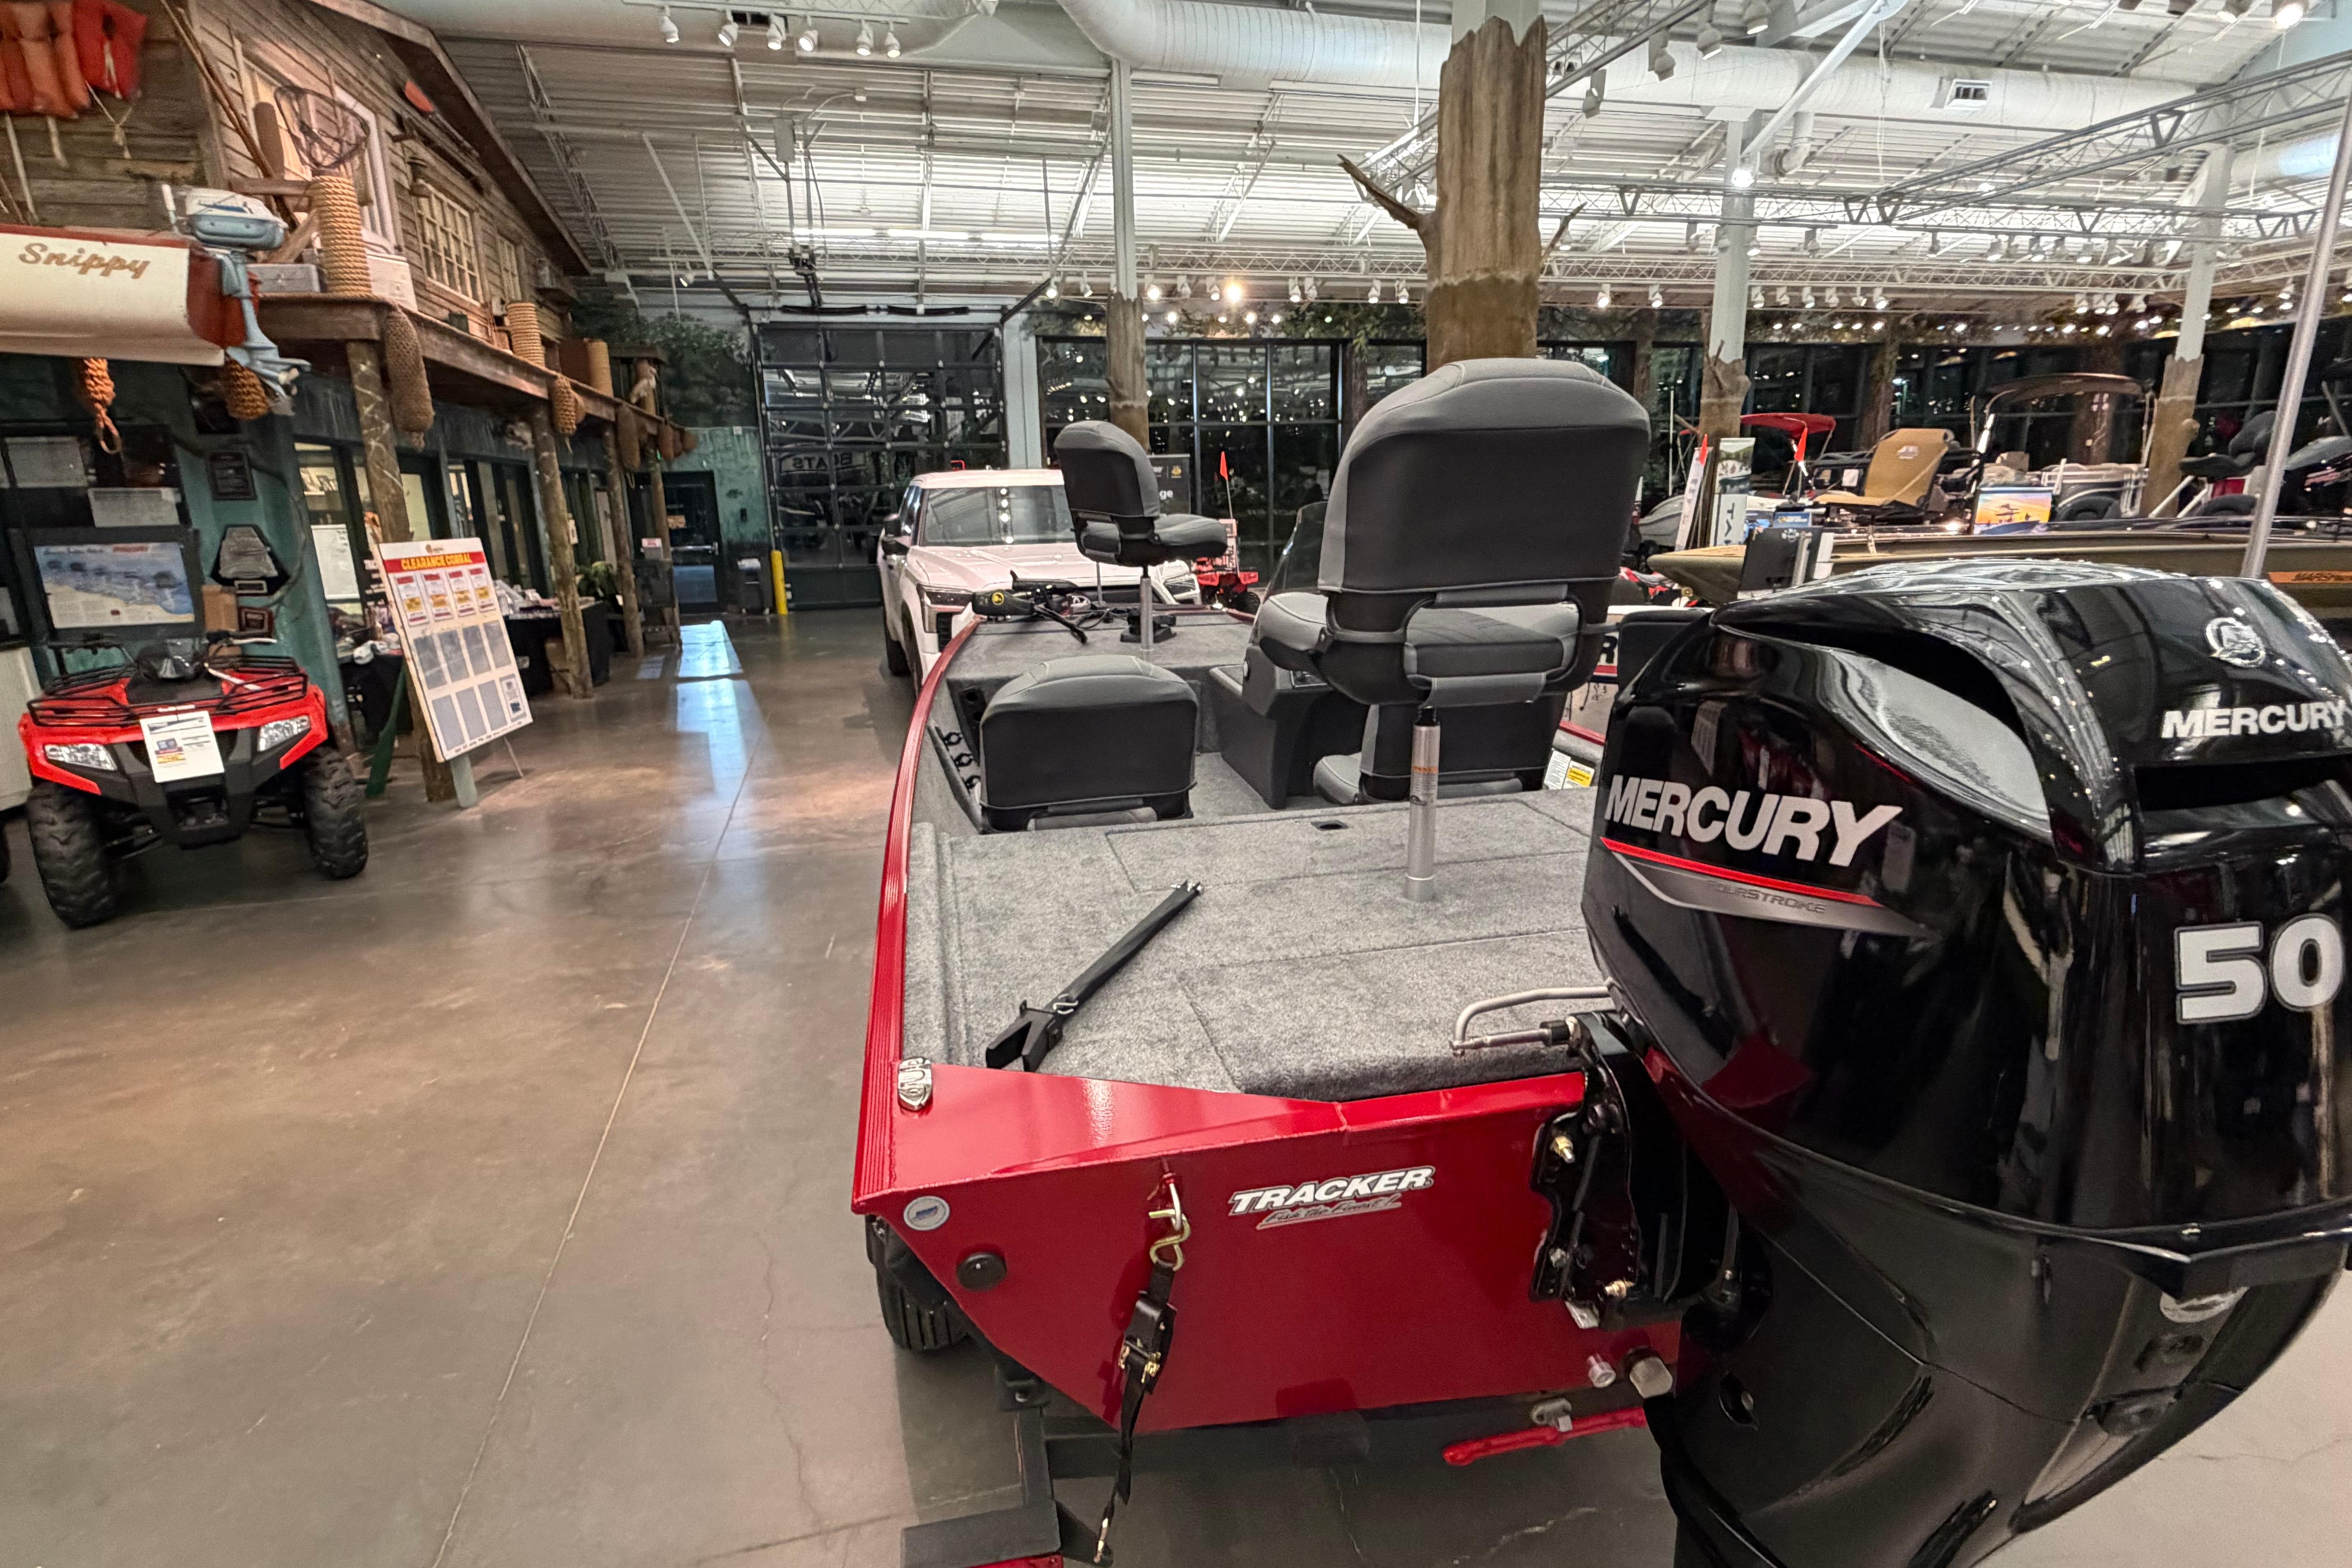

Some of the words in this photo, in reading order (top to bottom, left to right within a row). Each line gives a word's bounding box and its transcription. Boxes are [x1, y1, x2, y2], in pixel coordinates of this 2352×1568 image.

[19, 243, 150, 279] Snippy
[401, 556, 446, 570] CLEARANCE
[445, 553, 473, 565] CORRAL
[2161, 700, 2347, 739] MERCURY
[1604, 775, 1903, 867] MERCURY
[2174, 912, 2345, 1024] 50
[1230, 1167, 1435, 1215] TRACKER
